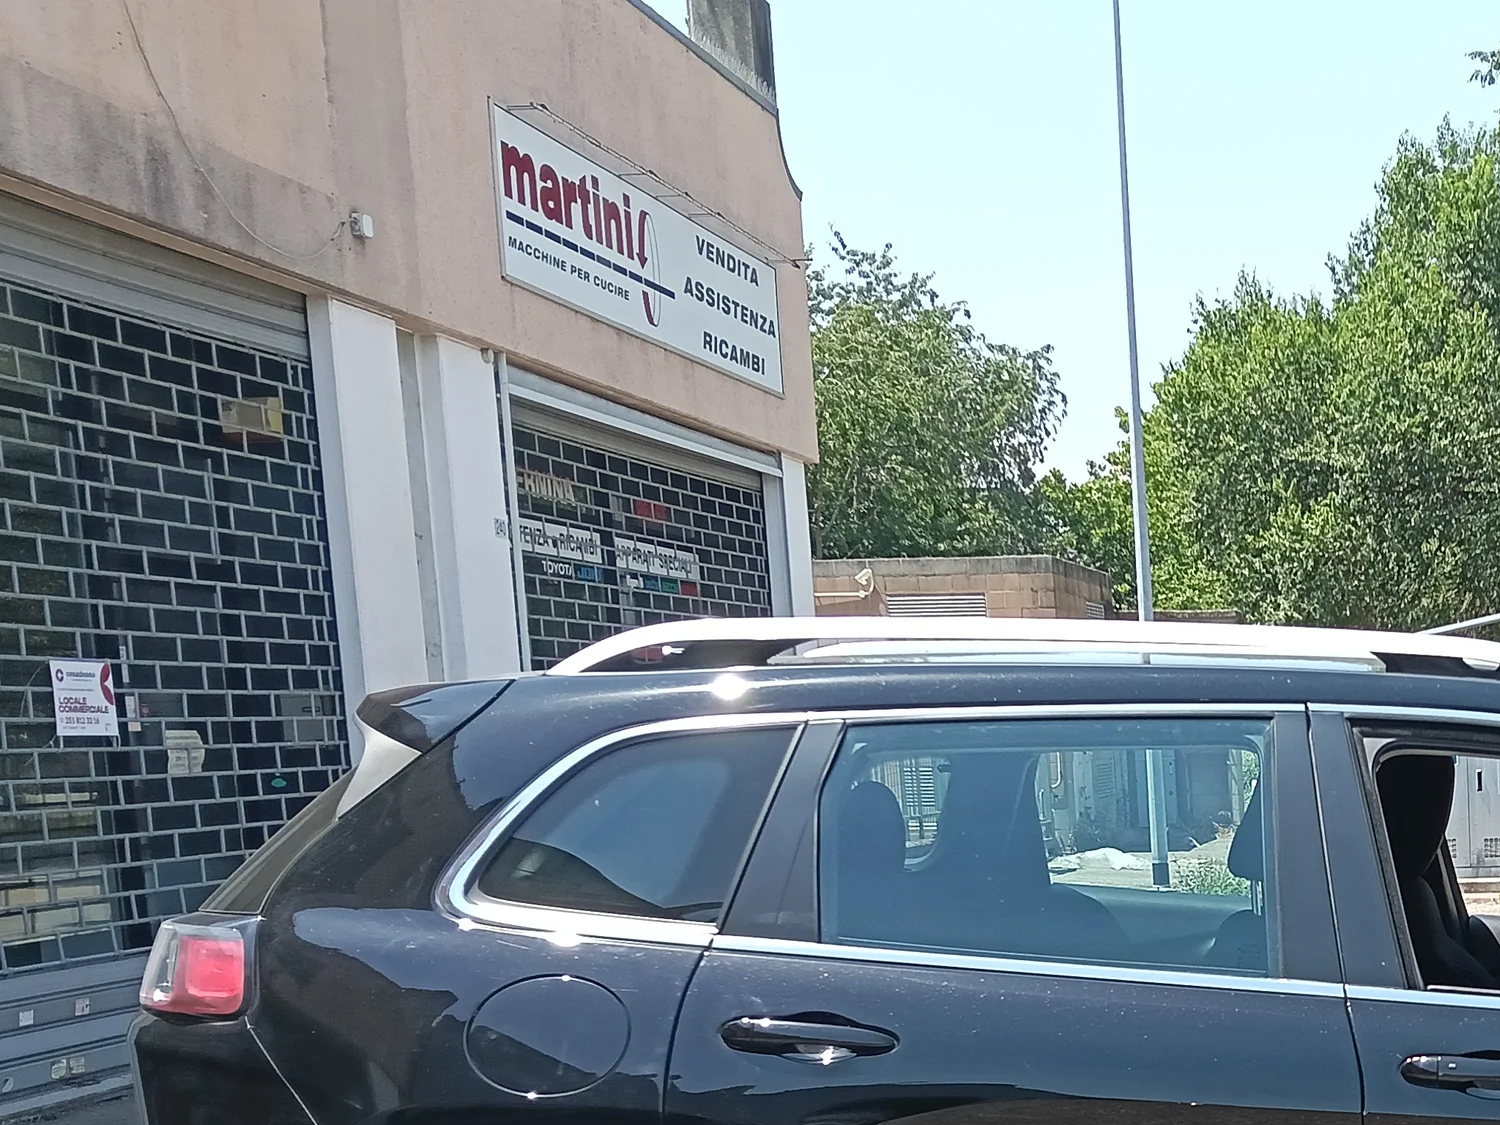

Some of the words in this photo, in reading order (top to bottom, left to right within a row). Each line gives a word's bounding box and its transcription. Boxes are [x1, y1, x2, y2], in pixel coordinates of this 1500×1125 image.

[500, 140, 635, 261] martini
[508, 235, 567, 272] MACCHINE
[570, 264, 591, 283] PER
[593, 275, 630, 301] CUCIRE
[695, 234, 759, 287] VENDITA
[683, 276, 777, 339] ASSISTENZA
[702, 330, 766, 376] RICAMBI
[58, 696, 88, 706] LOCALE
[58, 705, 110, 714] COMMERCIALE
